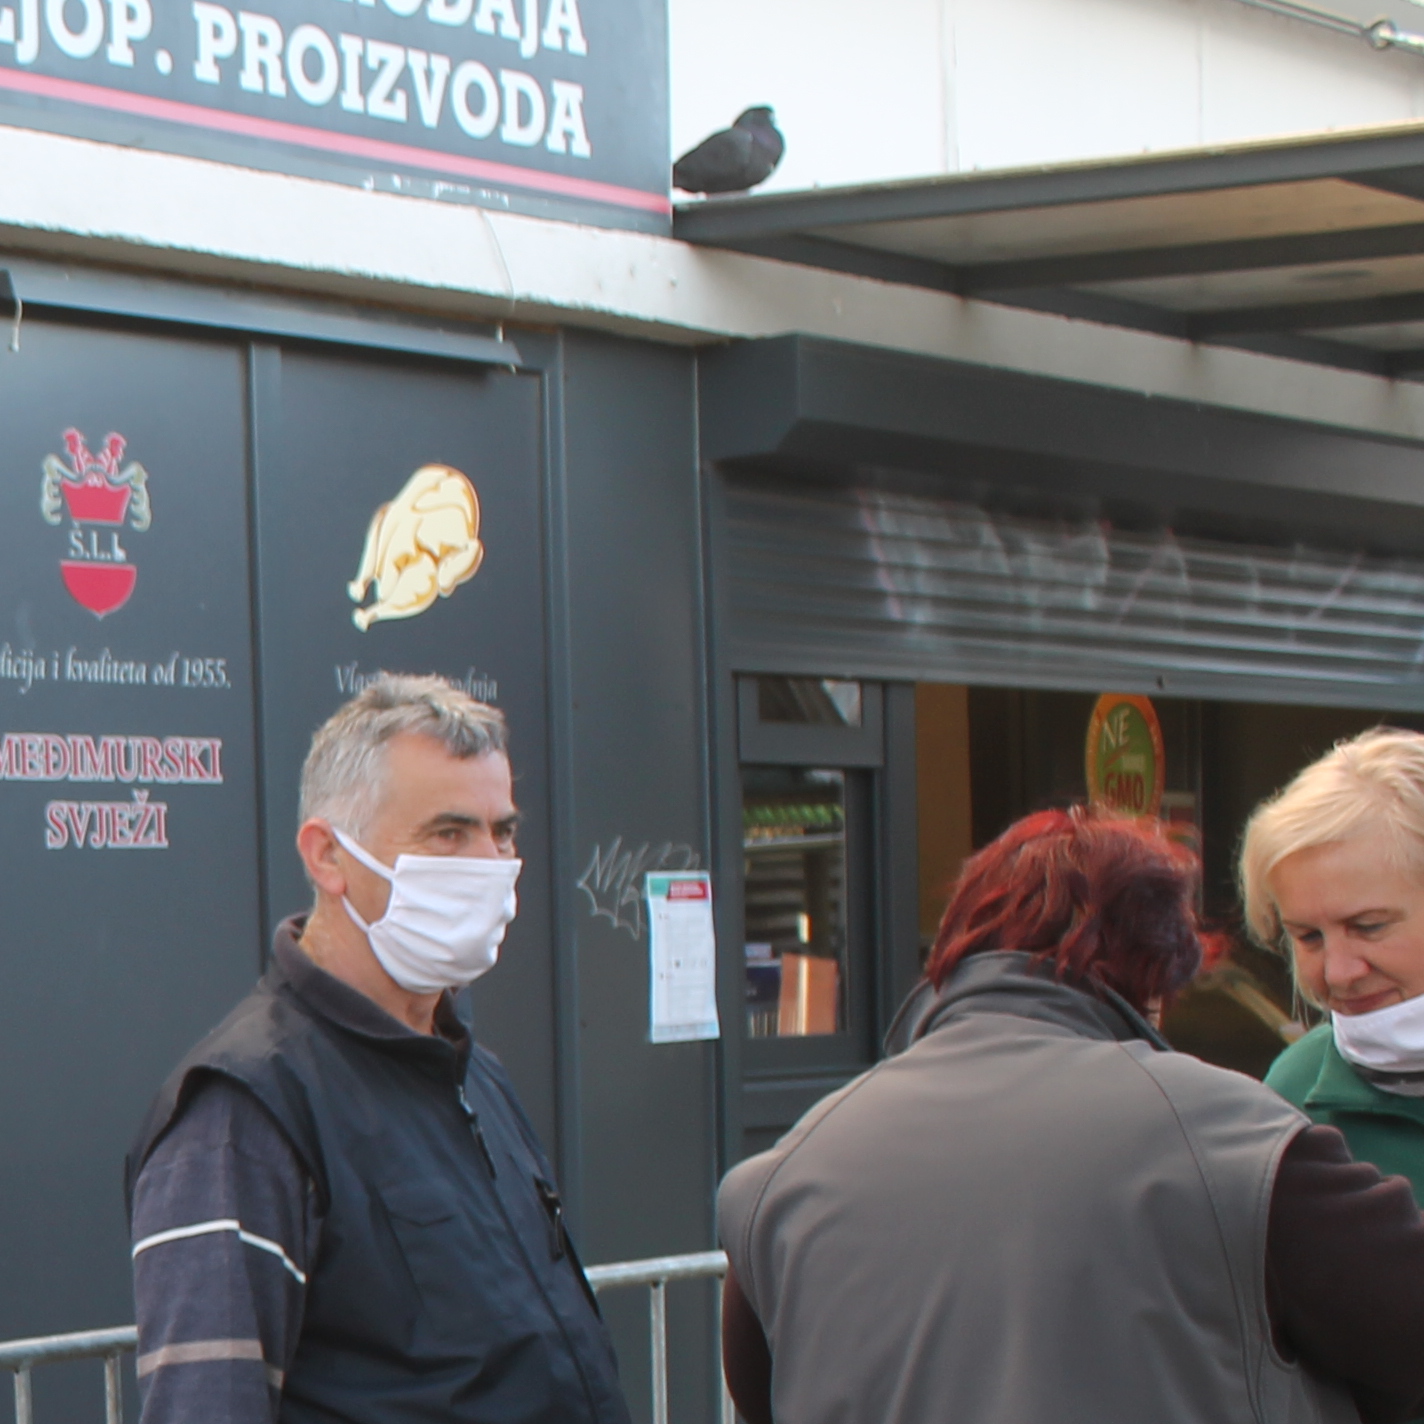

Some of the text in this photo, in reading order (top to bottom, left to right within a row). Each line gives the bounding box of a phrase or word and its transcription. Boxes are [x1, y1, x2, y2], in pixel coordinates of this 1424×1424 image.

[192, 0, 592, 158] PROIZVODA
[52, 650, 60, 680] i
[66, 646, 147, 685] kvaliteta
[153, 651, 180, 686] od
[182, 657, 231, 688] 1955.
[45, 788, 169, 849] SVJEŽI
